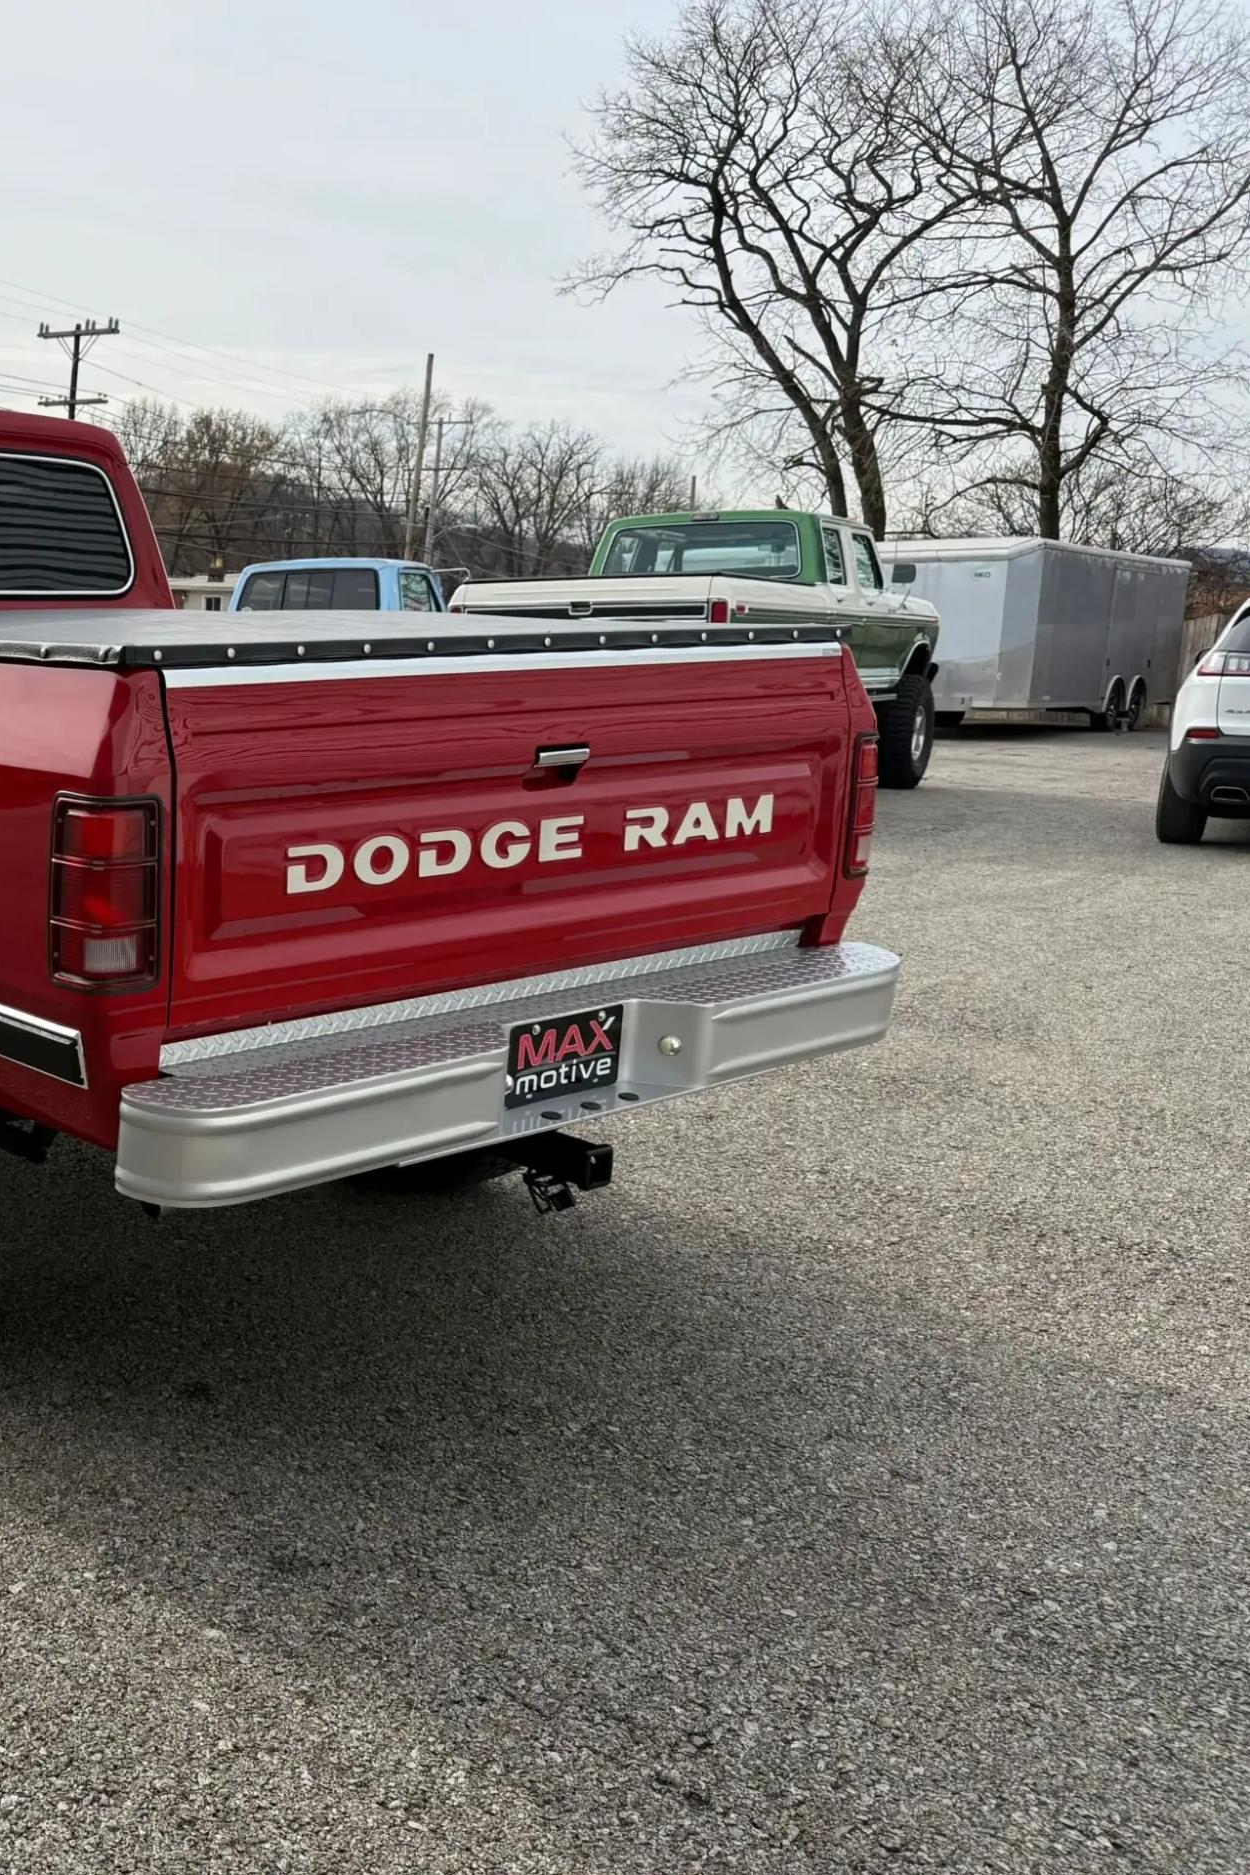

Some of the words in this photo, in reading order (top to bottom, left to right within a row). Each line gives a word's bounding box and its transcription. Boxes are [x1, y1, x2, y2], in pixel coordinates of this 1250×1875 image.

[286, 814, 584, 894] DODGE
[623, 793, 774, 852] RAM
[517, 1016, 616, 1070] MAX
[515, 1057, 612, 1095] motive
